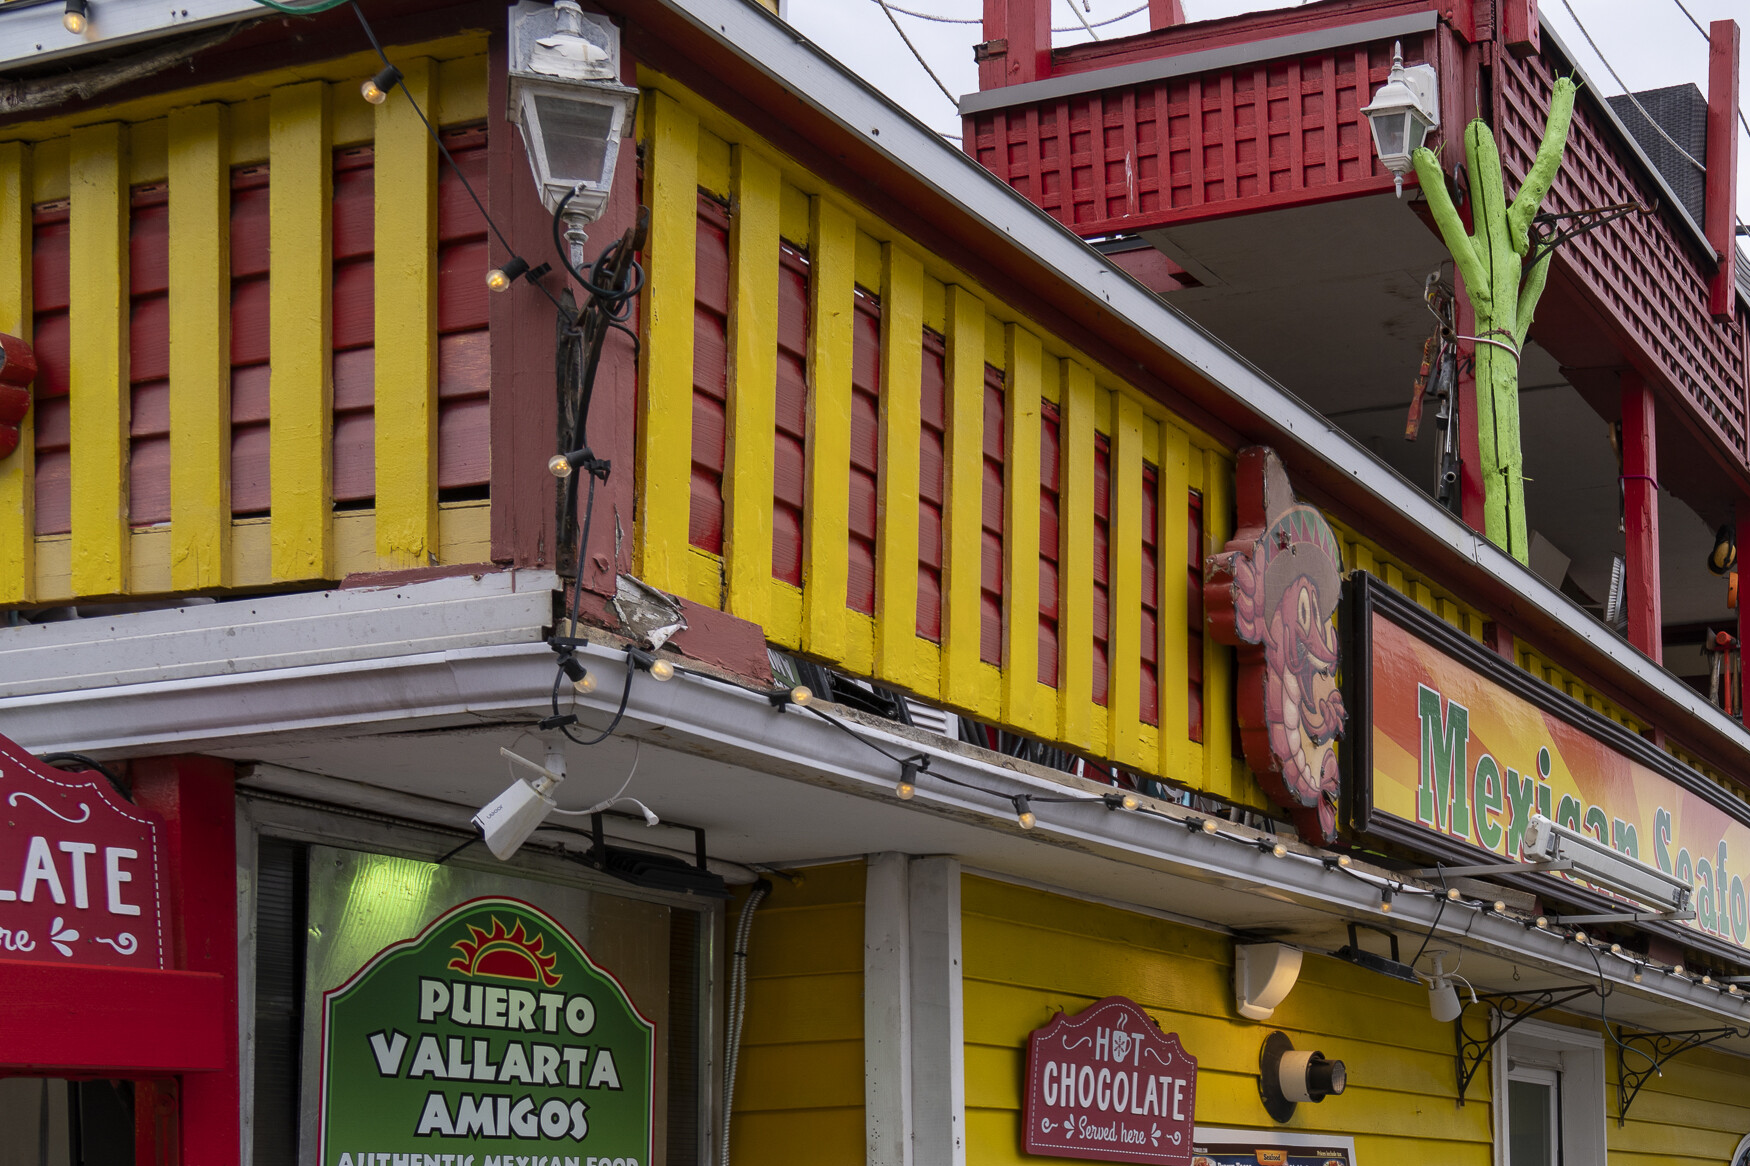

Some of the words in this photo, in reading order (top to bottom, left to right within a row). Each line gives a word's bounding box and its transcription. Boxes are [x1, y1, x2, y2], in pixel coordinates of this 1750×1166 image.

[419, 979, 596, 1036] PUERTO
[368, 1031, 623, 1091] VALLARTA
[415, 1093, 590, 1142] AMIGOS
[1043, 1060, 1188, 1122] CHOCOLATE
[1078, 1114, 1119, 1144] Served
[1120, 1121, 1147, 1146] here
[1263, 1153, 1281, 1161] Seafood
